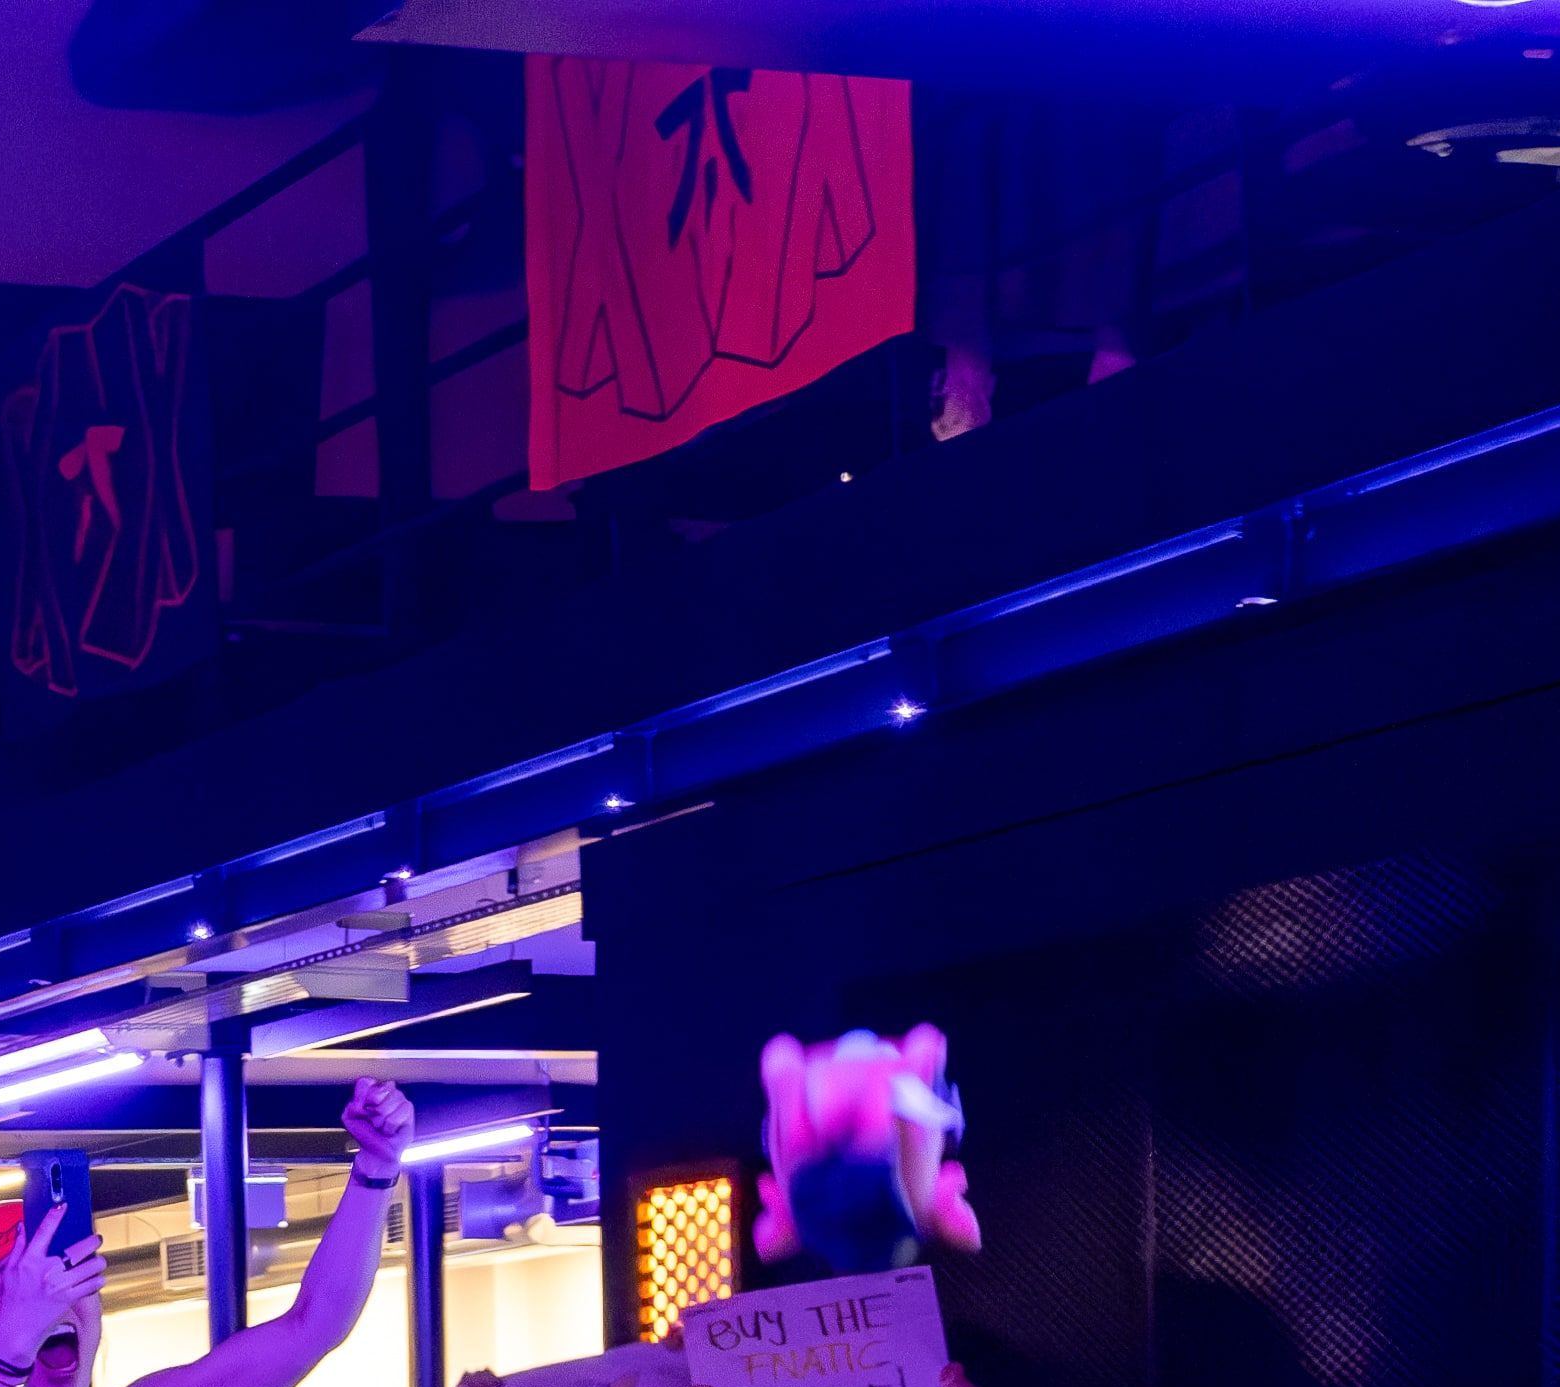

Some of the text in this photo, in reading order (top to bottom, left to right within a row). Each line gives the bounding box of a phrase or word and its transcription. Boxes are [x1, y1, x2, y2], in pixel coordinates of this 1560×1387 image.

[707, 1293, 894, 1351] BUY THE
[743, 1340, 890, 1384] FNATIC
